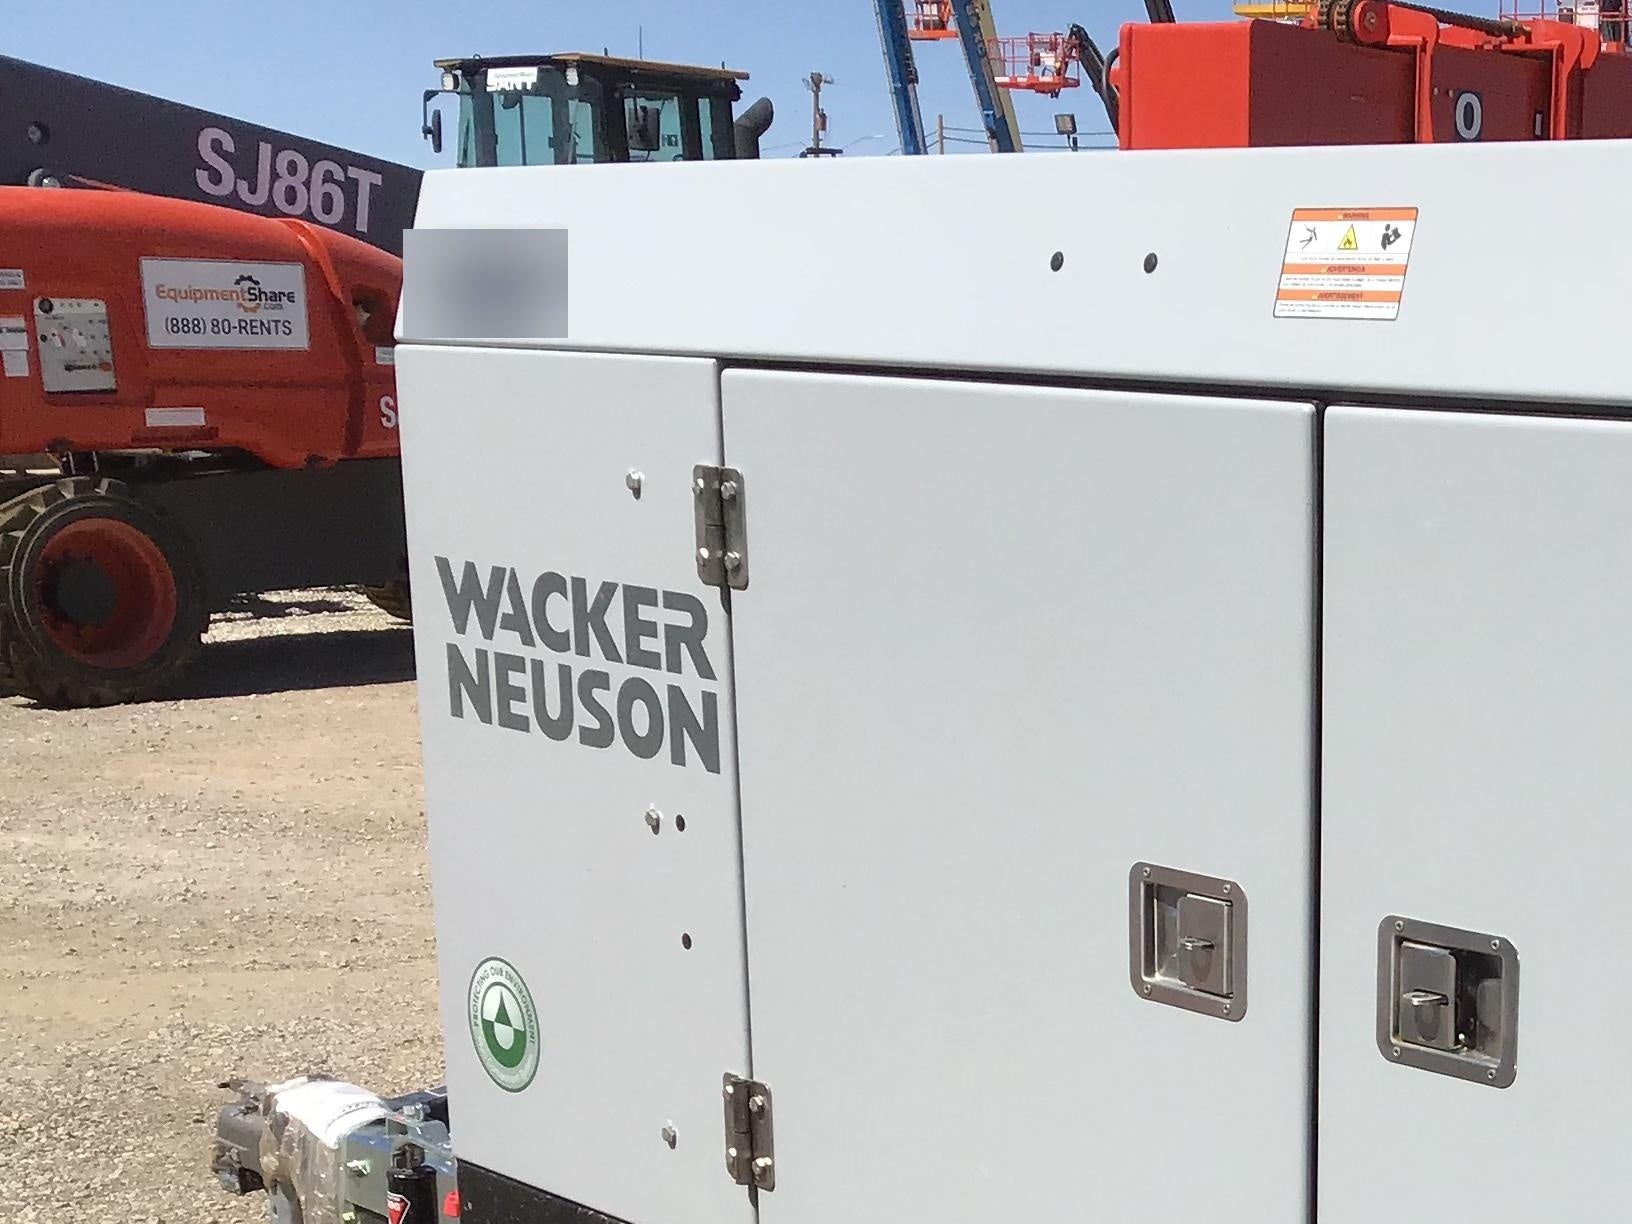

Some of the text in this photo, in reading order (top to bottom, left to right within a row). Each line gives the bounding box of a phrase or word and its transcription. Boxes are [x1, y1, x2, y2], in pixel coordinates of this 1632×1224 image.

[195, 127, 382, 234] SJ86T
[155, 284, 296, 304] EquipmentShare
[165, 317, 293, 336] (888) 80-RENTS
[434, 555, 718, 681] WACKER
[446, 642, 721, 775] NEUSON
